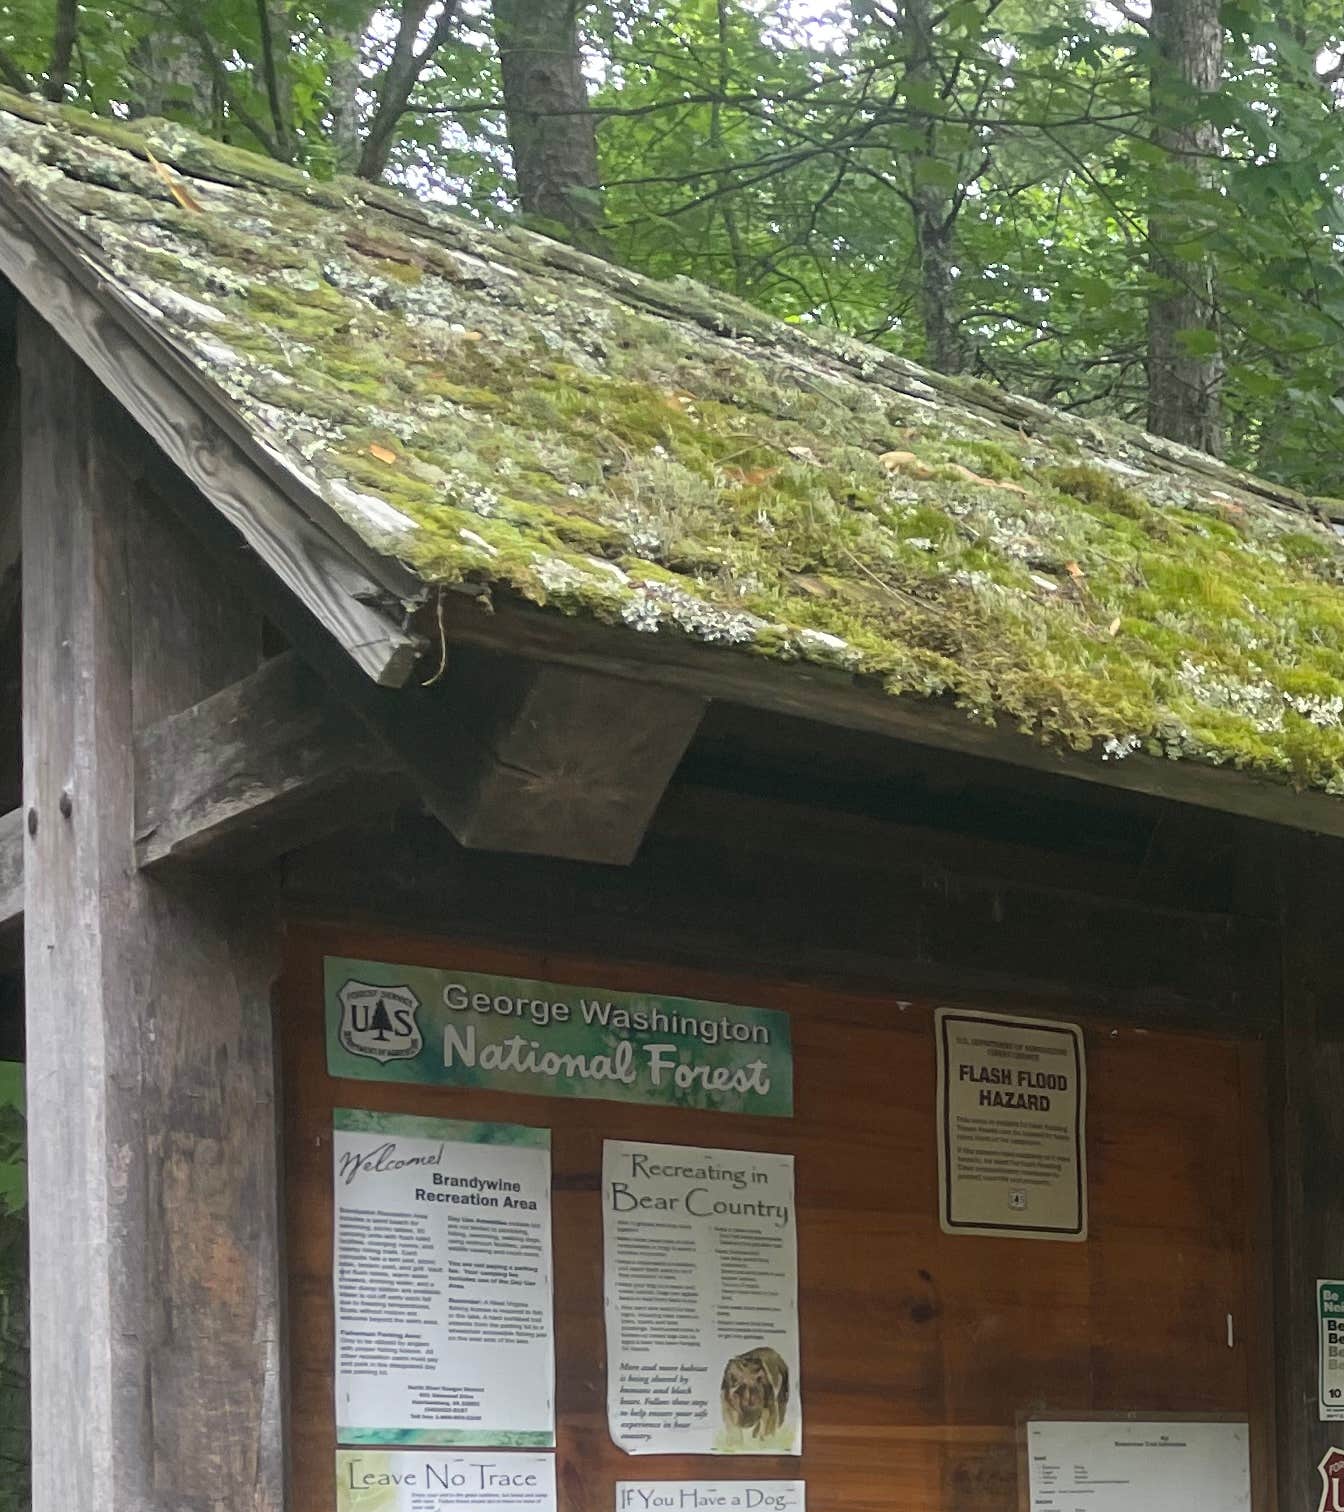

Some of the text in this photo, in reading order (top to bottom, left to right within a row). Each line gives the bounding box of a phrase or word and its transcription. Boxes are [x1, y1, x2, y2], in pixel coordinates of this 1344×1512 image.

[442, 983, 770, 1044] George Washington
[443, 1023, 770, 1095] National Forest
[959, 1064, 1068, 1091] FLASH FLOOD
[979, 1089, 1050, 1112] HAZARD
[432, 1172, 521, 1194] Brandywine
[631, 1154, 769, 1191] Recreating in
[415, 1188, 538, 1211] Recreation Area
[611, 1182, 789, 1227] Bear Country
[1323, 1290, 1338, 1301] Be
[1329, 1388, 1341, 1399] 10
[348, 1459, 537, 1490] Leave No Trace
[621, 1488, 635, 1509] If
[637, 1488, 674, 1509] You
[679, 1488, 727, 1508] Have
[731, 1495, 741, 1506] a
